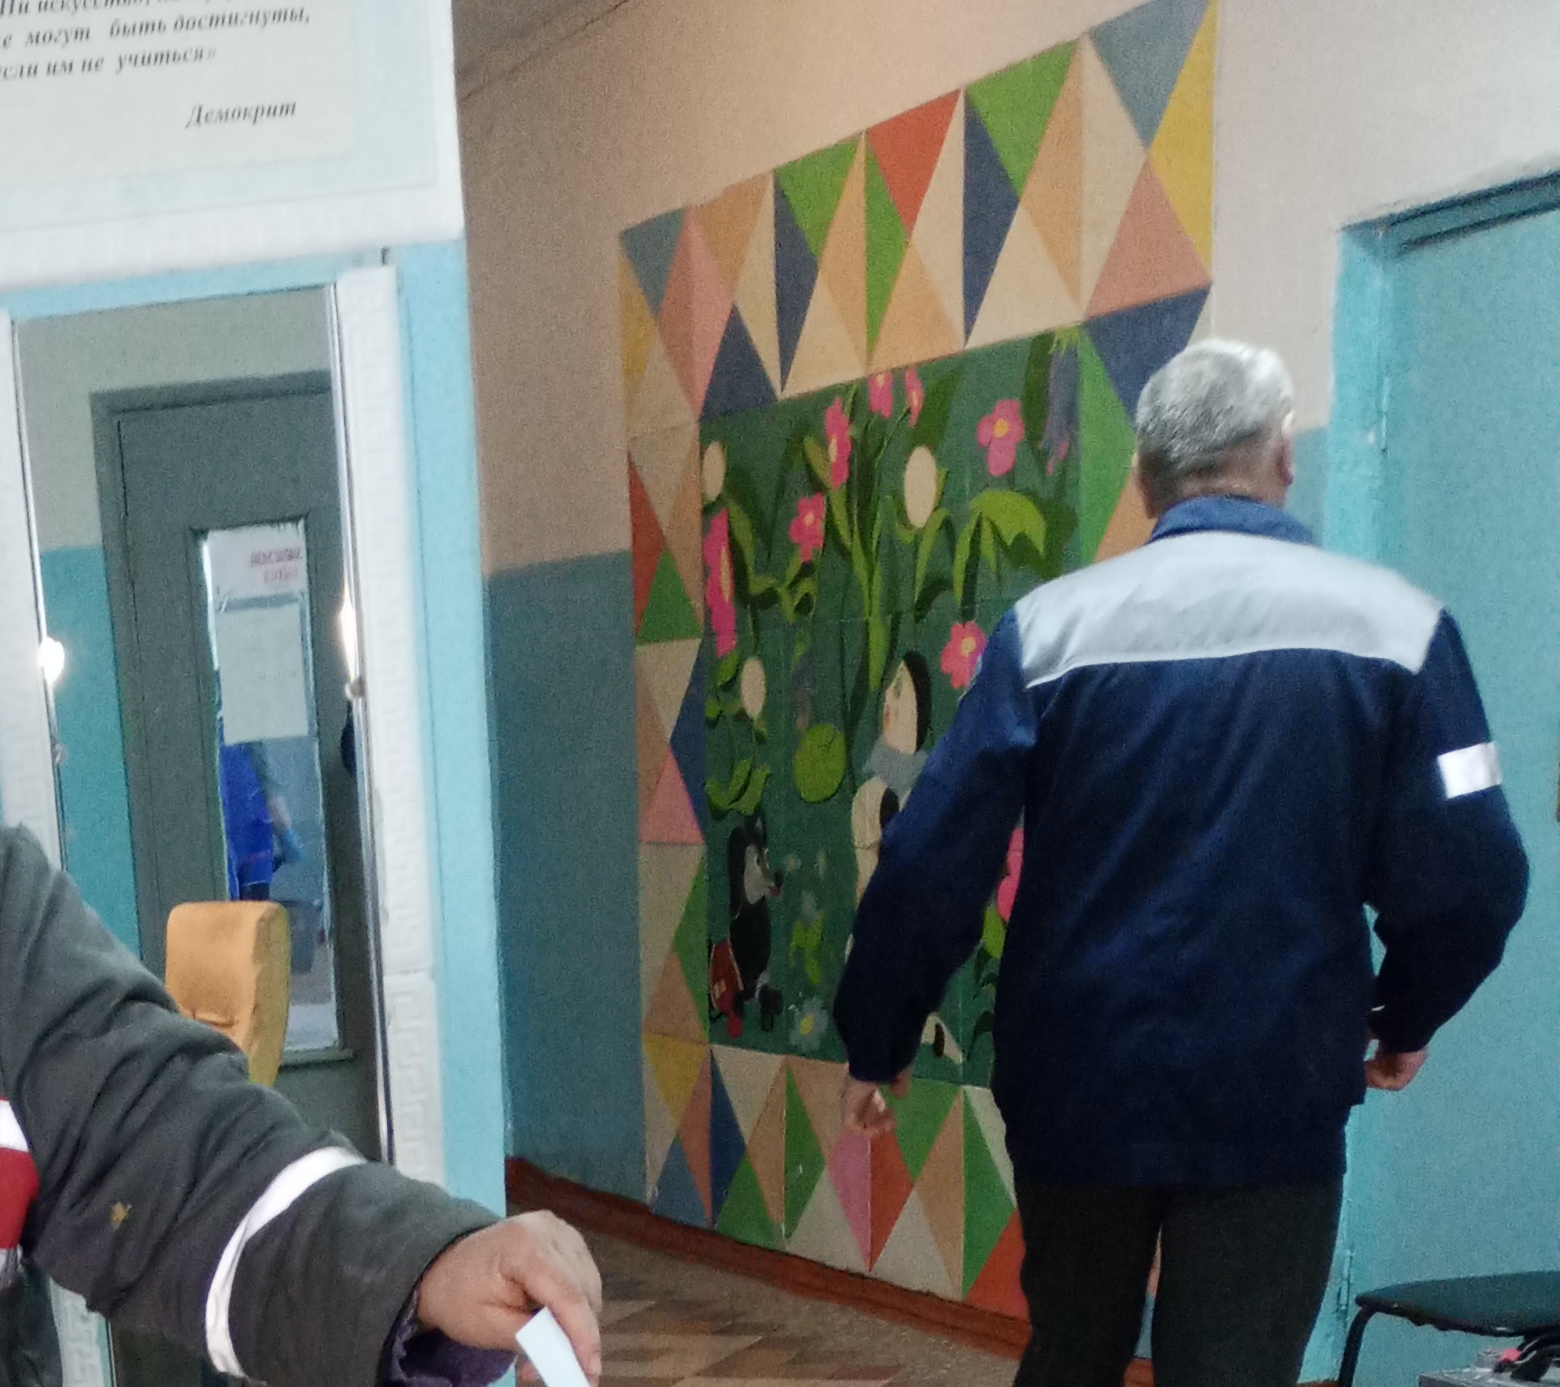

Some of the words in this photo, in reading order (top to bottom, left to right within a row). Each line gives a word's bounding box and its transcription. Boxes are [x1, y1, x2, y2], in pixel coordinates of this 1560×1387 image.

[25, 27, 90, 48] могут
[109, 19, 167, 38] быть
[173, 7, 310, 32] достигнуты,
[46, 59, 74, 76] им
[81, 57, 104, 73] не
[116, 48, 216, 75] учиться»
[185, 102, 296, 129] Демокрит
